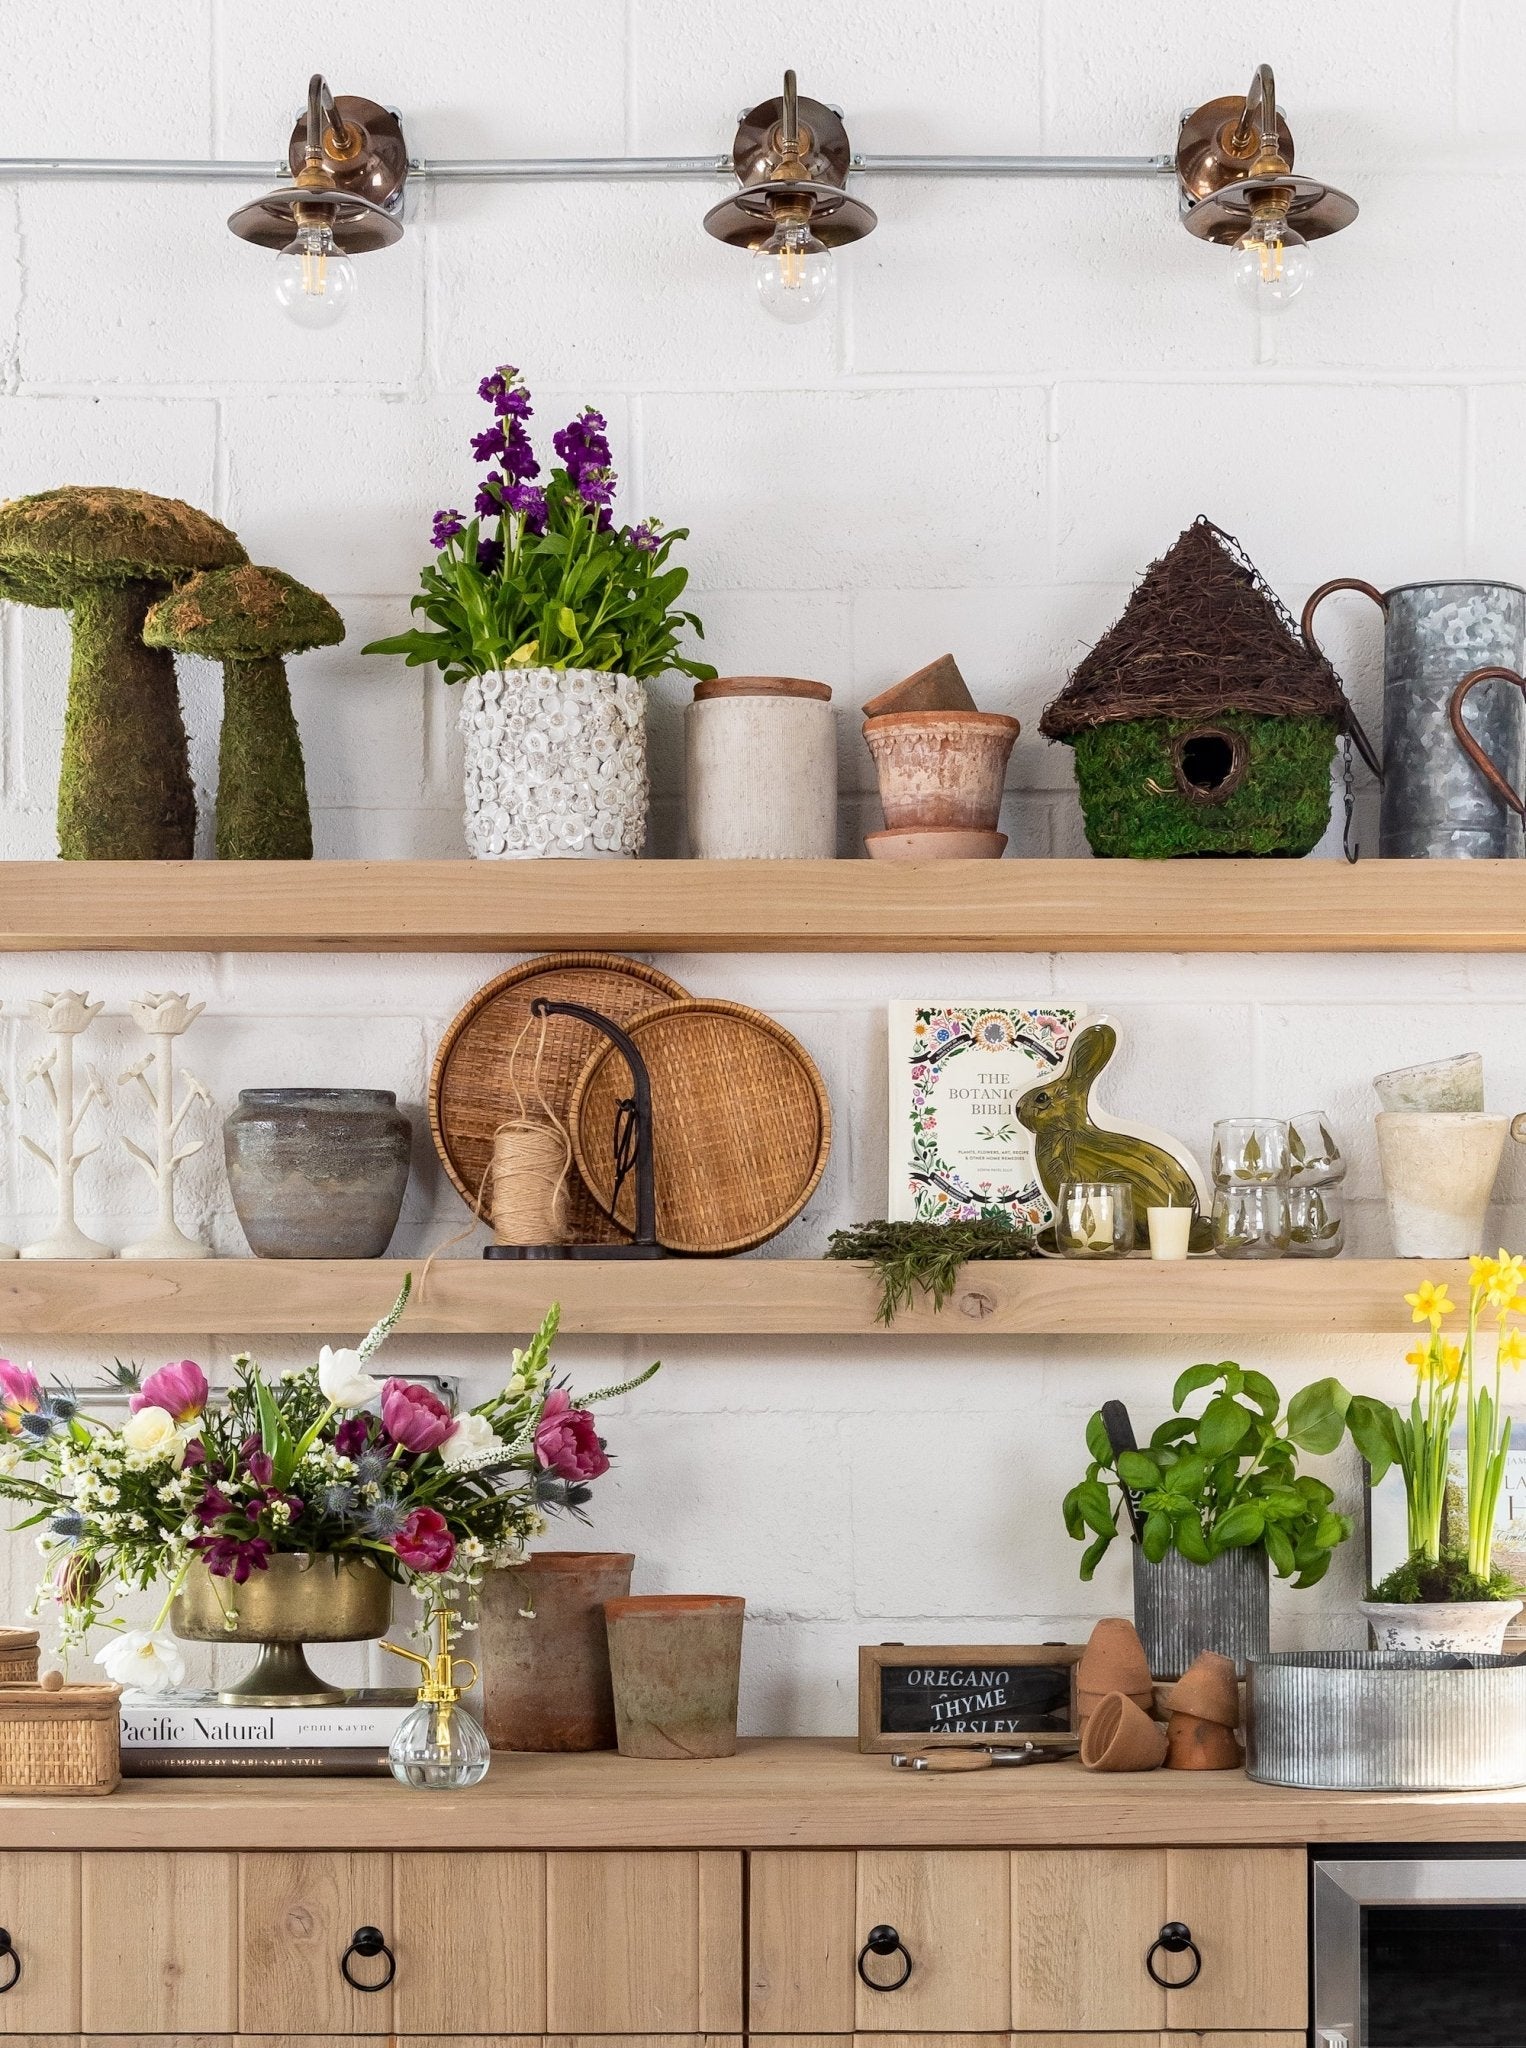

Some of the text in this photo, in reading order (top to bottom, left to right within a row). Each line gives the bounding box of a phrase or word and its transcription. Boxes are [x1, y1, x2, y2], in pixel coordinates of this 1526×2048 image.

[977, 1073, 1010, 1084] THE
[949, 1088, 1018, 1100] BOTANIC
[1129, 1485, 1149, 1519] SIL
[907, 1670, 1010, 1687] OREGANO
[931, 1688, 1007, 1720] THYME
[192, 1717, 275, 1740] Natural
[139, 1758, 323, 1767] CONTEMPORARY WABI-SABI STYLE
